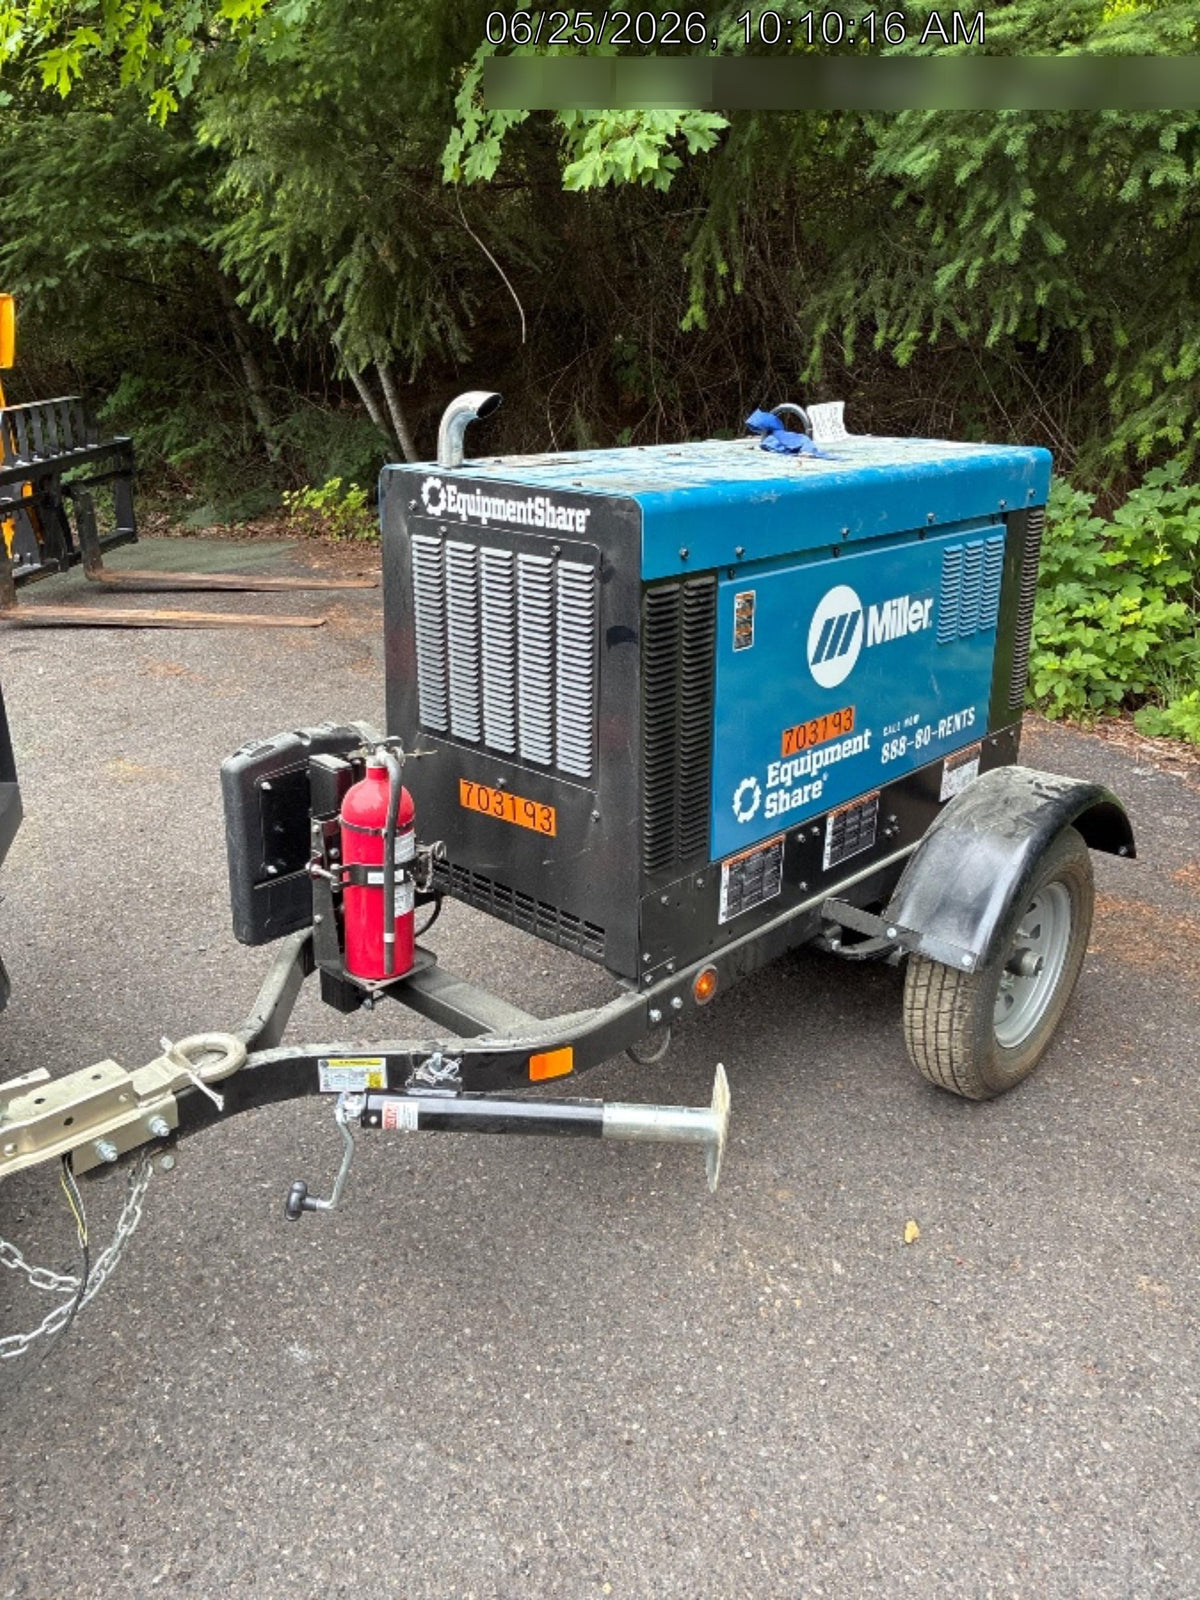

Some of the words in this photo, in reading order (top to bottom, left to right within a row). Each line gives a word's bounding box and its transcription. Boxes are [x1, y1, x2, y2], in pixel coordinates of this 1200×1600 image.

[446, 484, 588, 534] EquipmentShare
[866, 595, 934, 648] Miller
[783, 706, 853, 754] 703193
[881, 705, 976, 764] 888-80-RENTS
[766, 728, 872, 788] Equipment
[462, 781, 552, 833] 703193
[764, 778, 823, 819] Share
